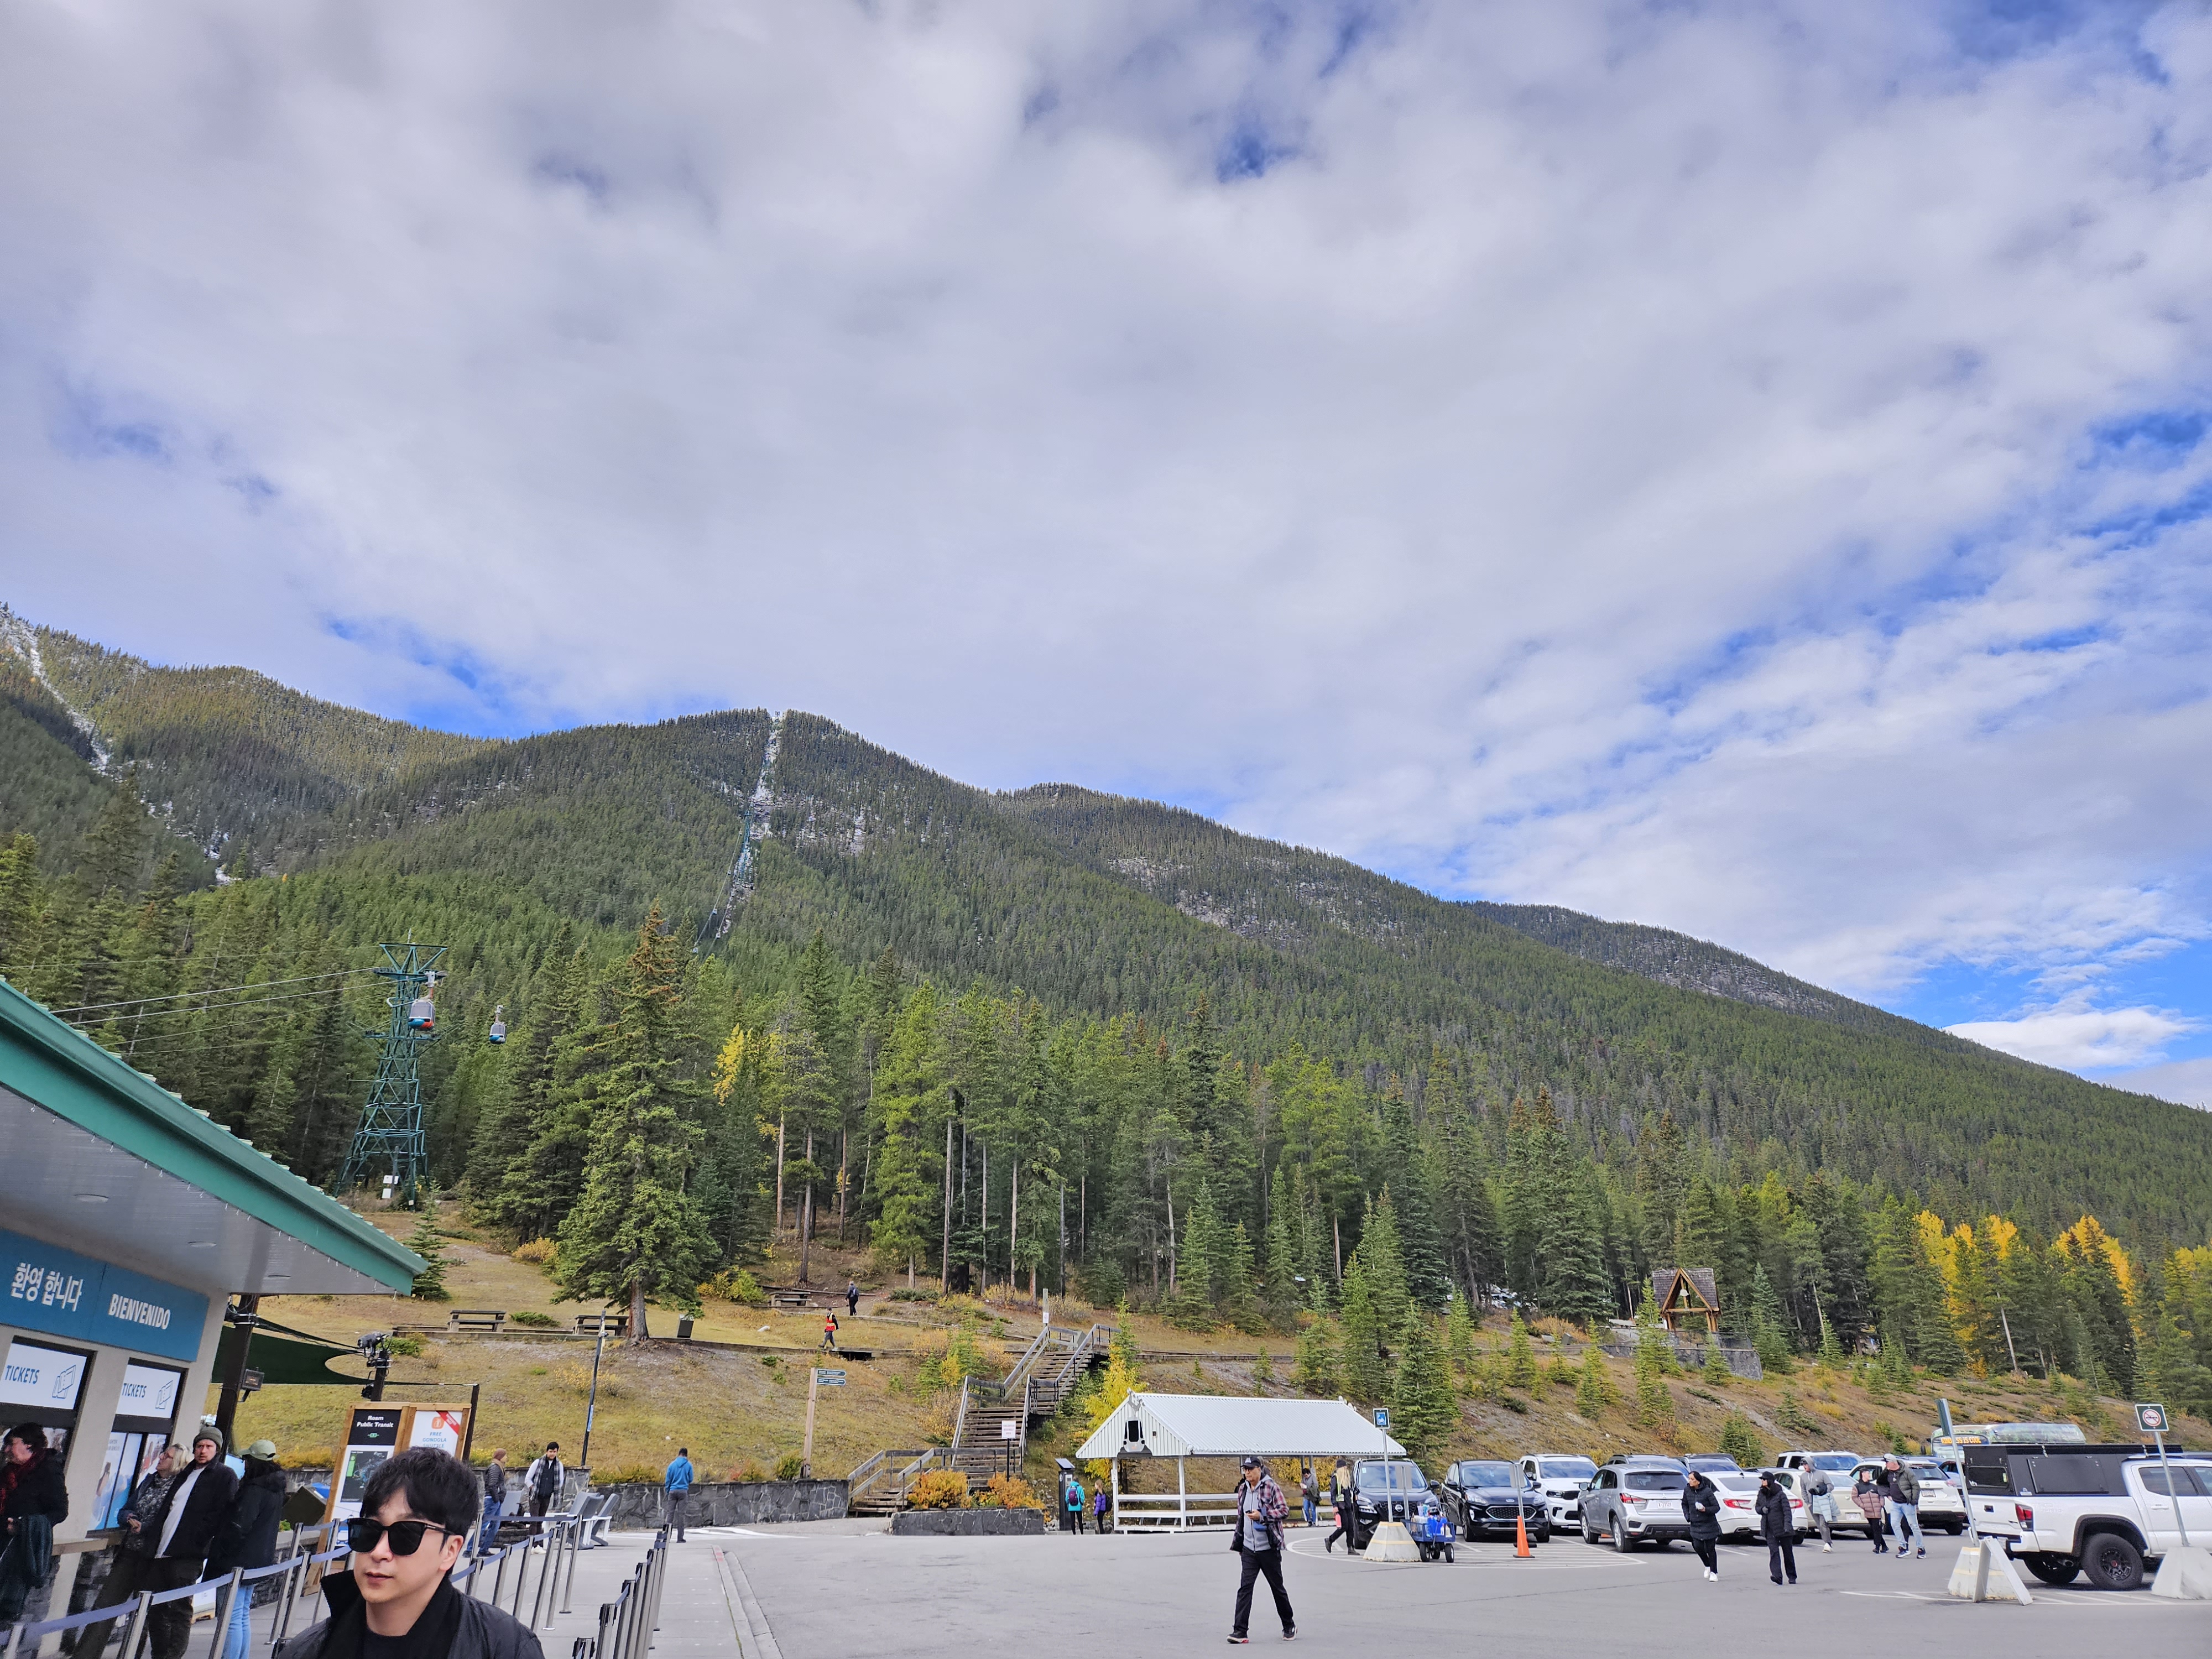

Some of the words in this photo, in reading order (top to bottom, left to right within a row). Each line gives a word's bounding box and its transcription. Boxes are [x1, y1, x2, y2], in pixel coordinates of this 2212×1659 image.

[11, 1262, 44, 1301] 환영
[42, 1271, 83, 1312] 합니다
[108, 1294, 170, 1329] BIENVENIDO
[5, 1365, 40, 1384] TICKETS
[122, 1383, 147, 1398] TICKETS
